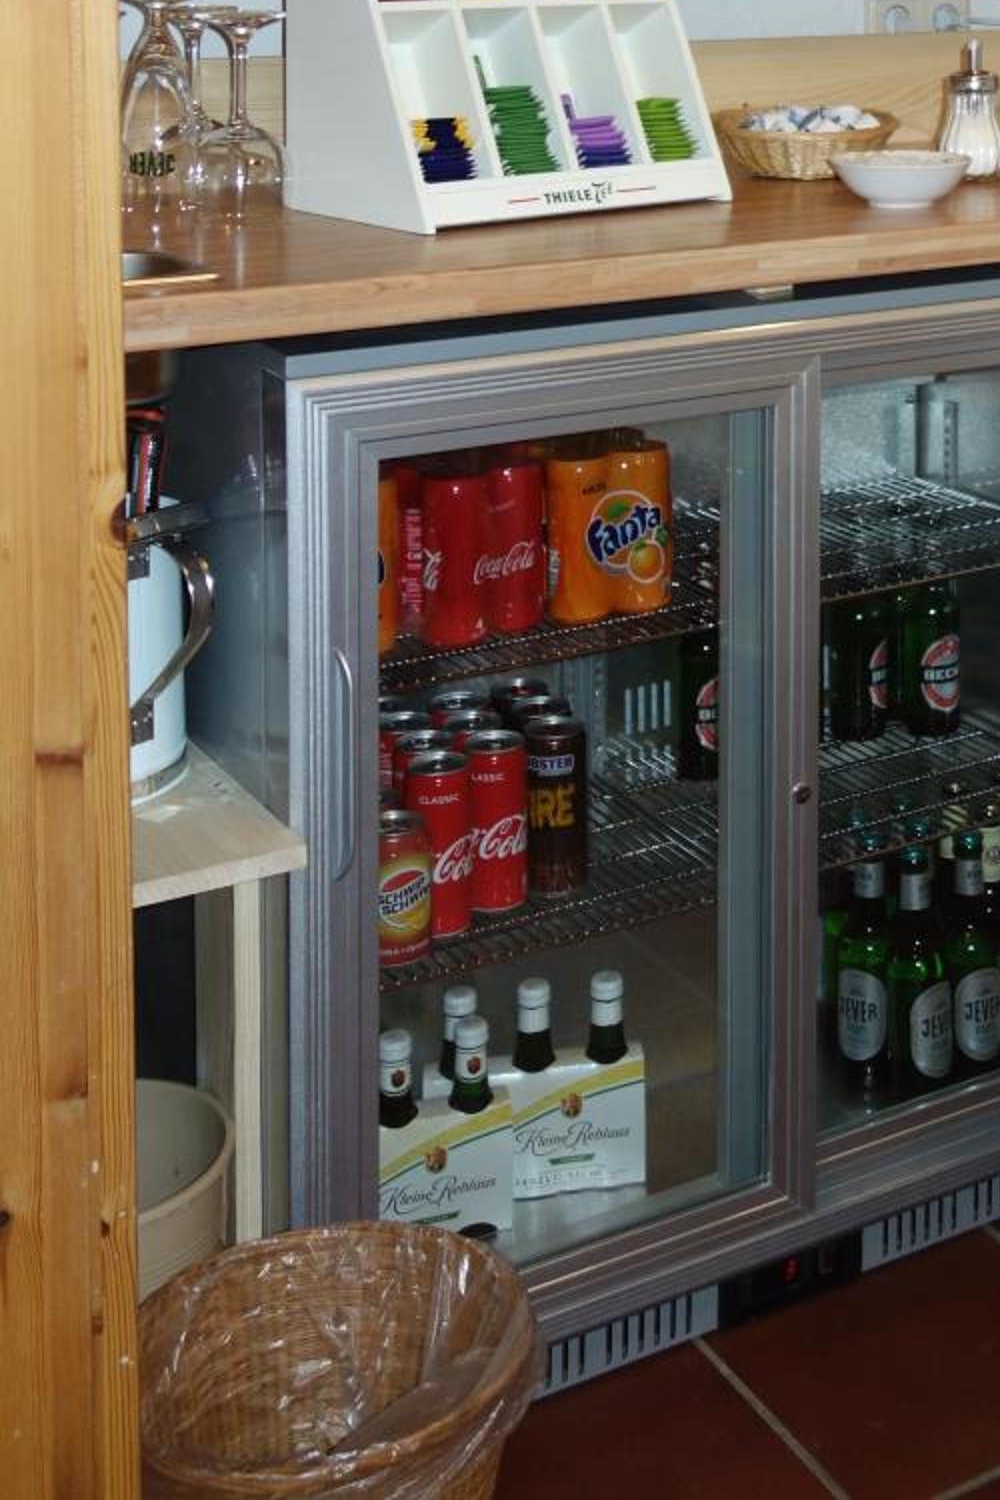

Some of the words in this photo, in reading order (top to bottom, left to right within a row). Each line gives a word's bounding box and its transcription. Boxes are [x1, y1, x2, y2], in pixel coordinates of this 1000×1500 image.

[544, 189, 592, 204] THIELE
[471, 772, 505, 783] LASSIC
[418, 792, 460, 805] CLASSIC
[531, 784, 576, 831] IRE
